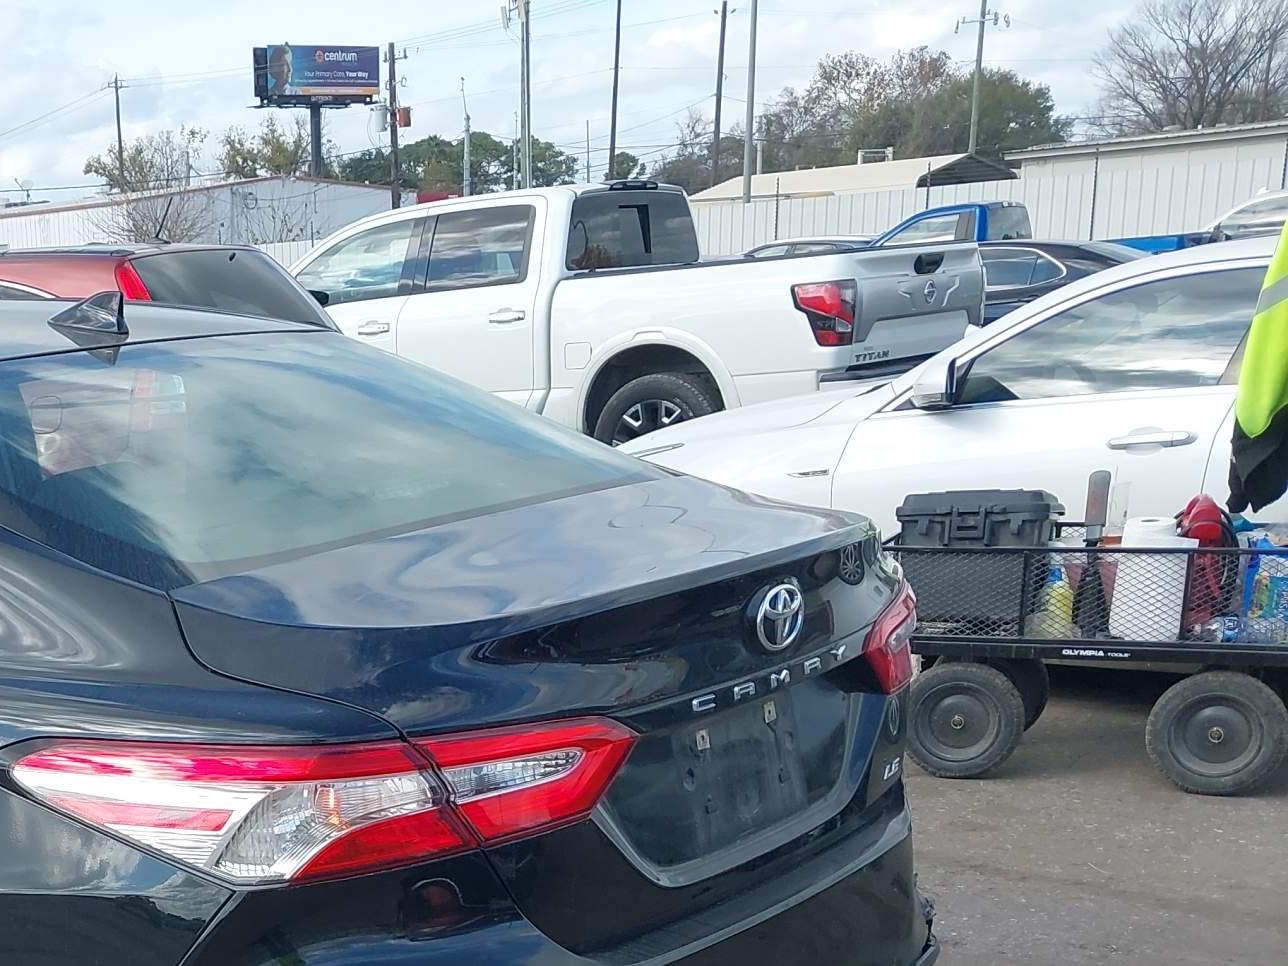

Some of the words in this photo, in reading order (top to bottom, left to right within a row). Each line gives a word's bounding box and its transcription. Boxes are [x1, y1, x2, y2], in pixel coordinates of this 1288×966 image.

[324, 50, 357, 61] centrum
[855, 350, 890, 362] TITAN
[1062, 649, 1105, 657] OLYMPIA
[692, 644, 847, 712] CAMRY
[883, 757, 901, 780] LE
